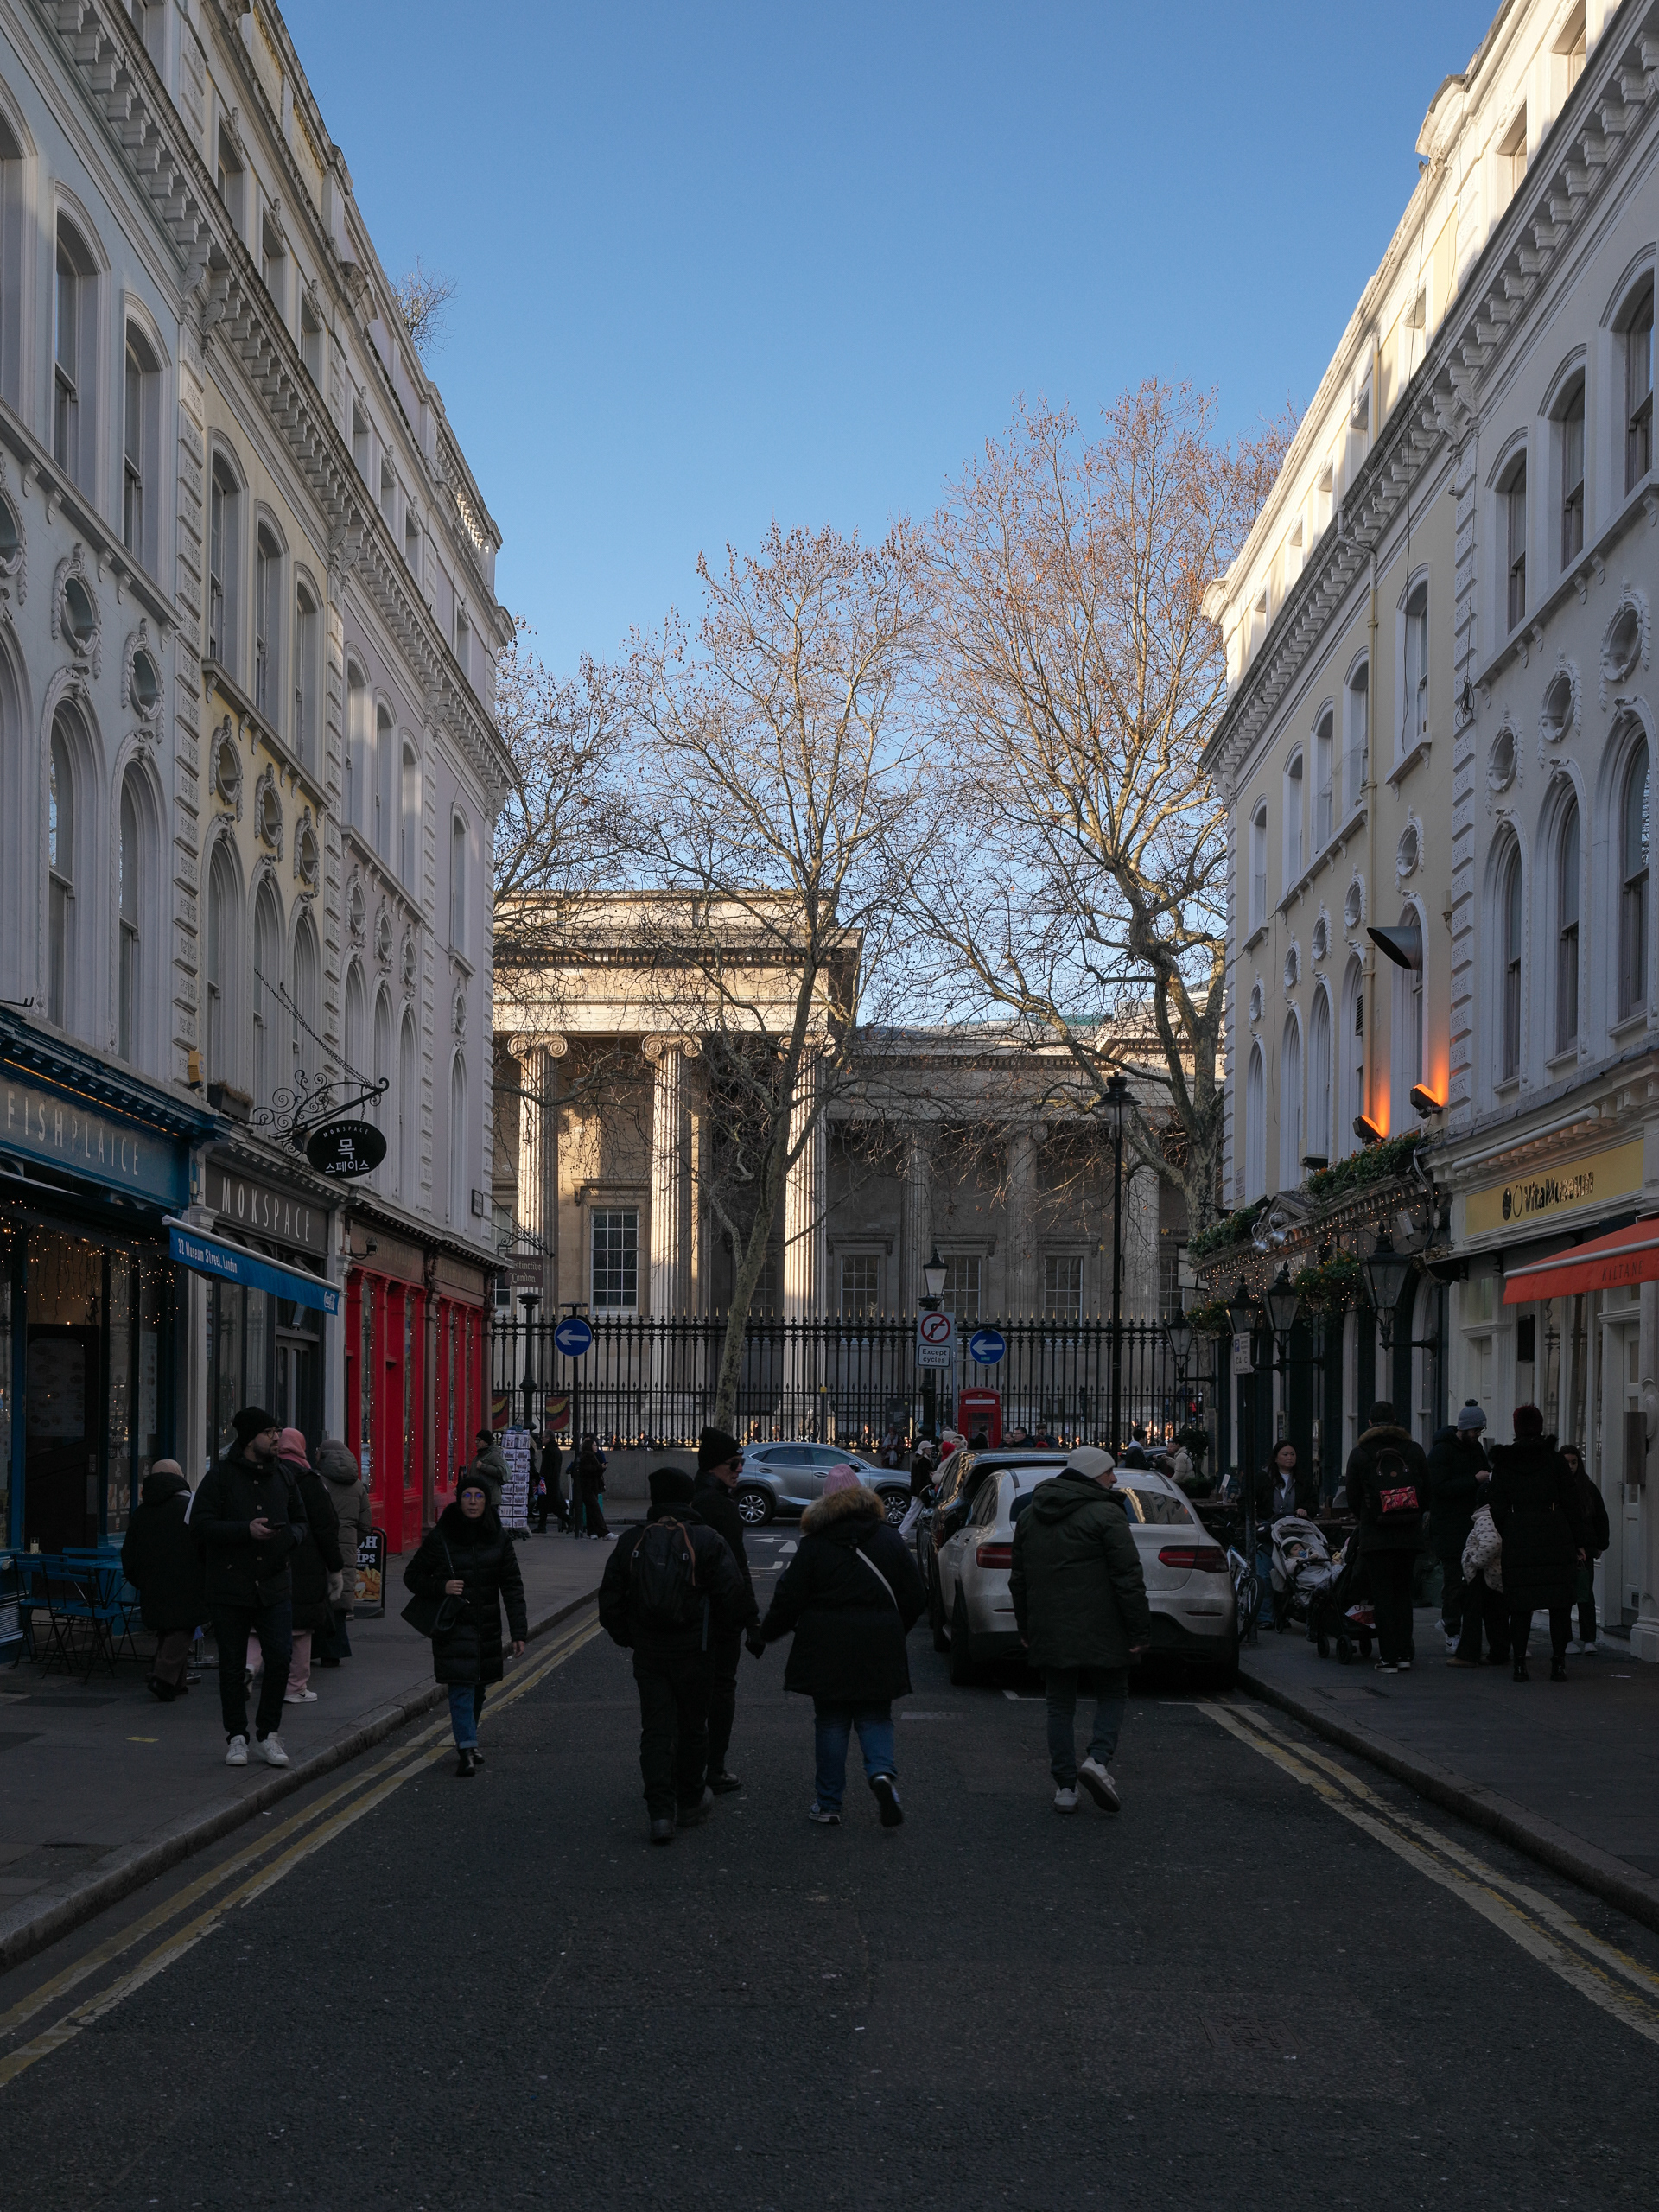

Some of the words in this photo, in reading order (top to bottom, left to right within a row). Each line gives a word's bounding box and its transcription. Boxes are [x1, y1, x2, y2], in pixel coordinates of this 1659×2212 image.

[8, 1090, 138, 1175] FISHPLAICE
[322, 1126, 369, 1138] MOKSPACE
[337, 1138, 355, 1160] 목
[324, 1160, 370, 1173] 스페이스
[222, 1177, 309, 1242] MOKSPACE
[178, 1237, 185, 1255] 32
[185, 1241, 204, 1262] Museum
[205, 1248, 222, 1268] Street,
[222, 1255, 238, 1274] London
[515, 1261, 542, 1270] stinctive
[1601, 1260, 1643, 1281] KILTANE
[509, 1272, 536, 1285] London
[356, 1554, 376, 1563] IPS
